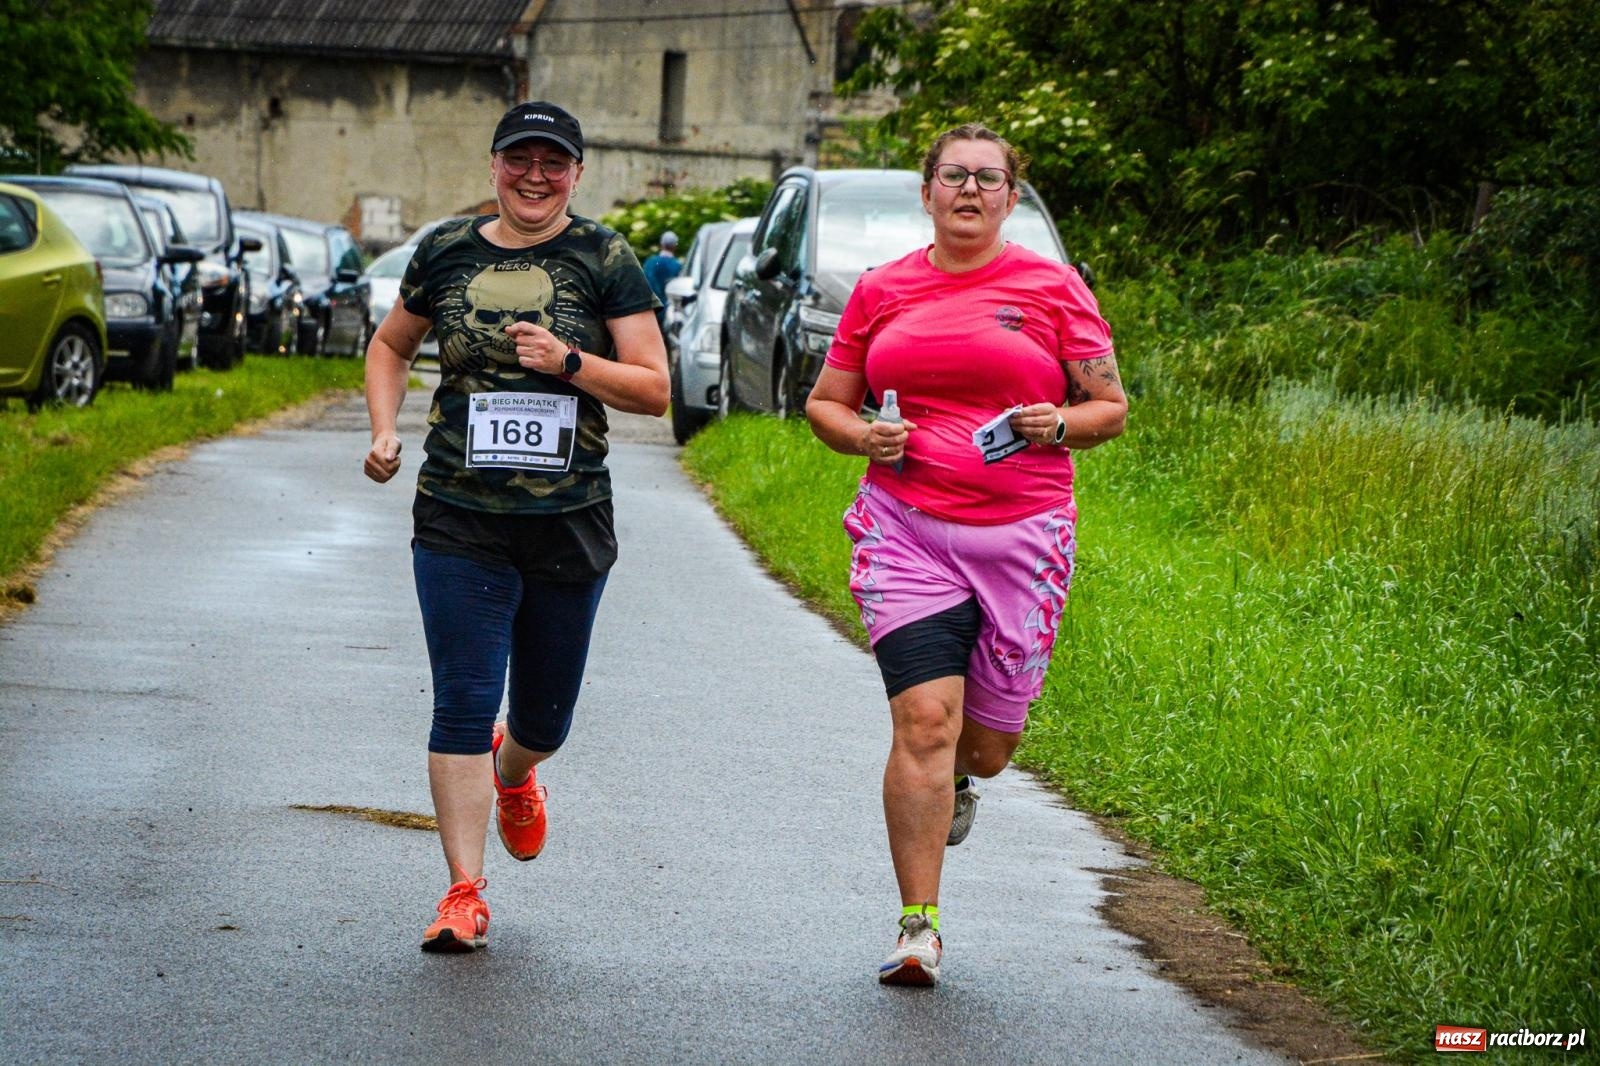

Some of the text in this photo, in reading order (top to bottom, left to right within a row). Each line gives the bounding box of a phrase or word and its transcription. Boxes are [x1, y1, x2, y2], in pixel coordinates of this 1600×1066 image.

[524, 113, 554, 123] KIPRUN
[497, 262, 530, 271] HERO
[527, 399, 557, 409] PIĄTKĘ
[490, 420, 543, 447] 168
